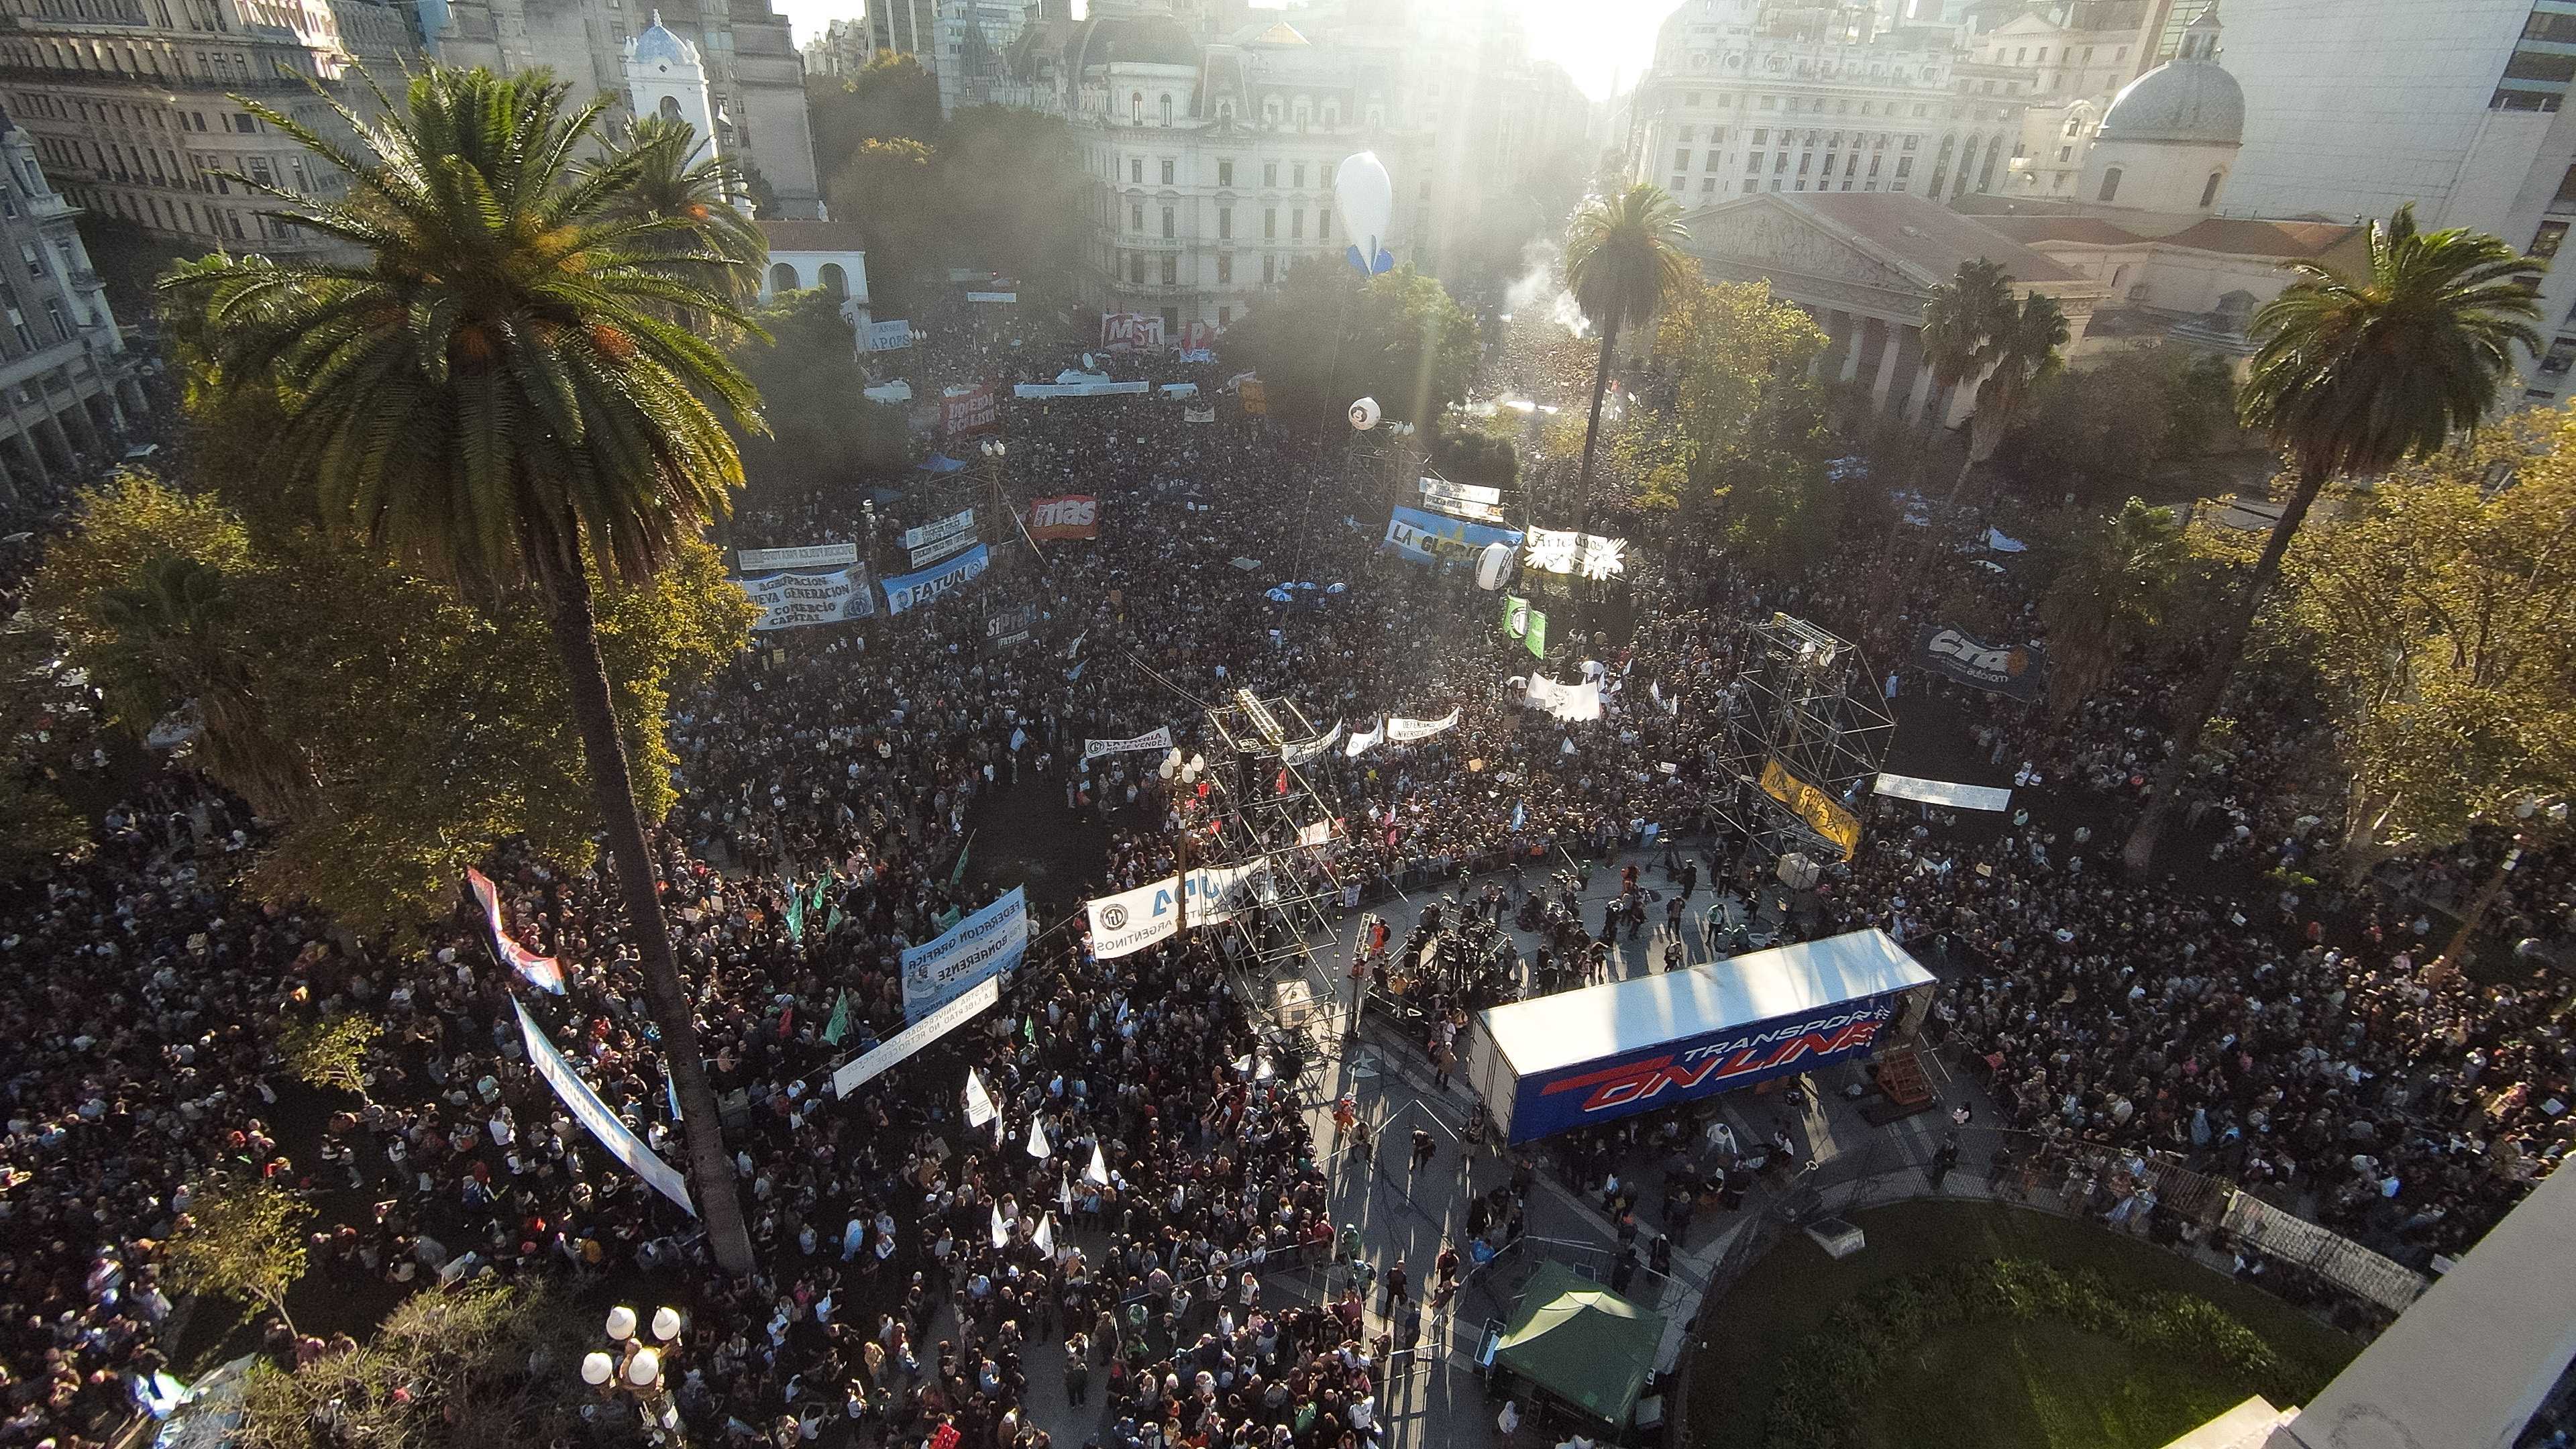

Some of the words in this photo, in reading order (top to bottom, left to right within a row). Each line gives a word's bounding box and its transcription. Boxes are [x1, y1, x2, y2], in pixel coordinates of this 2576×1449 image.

[1034, 500, 1095, 527] mas
[1393, 525, 1412, 545] LA
[784, 584, 851, 599] GENERACION
[912, 566, 966, 602] FATUN
[774, 602, 837, 616] COMERCIO
[771, 612, 824, 625] CAPITAL
[1134, 738, 1167, 749] VENDE!
